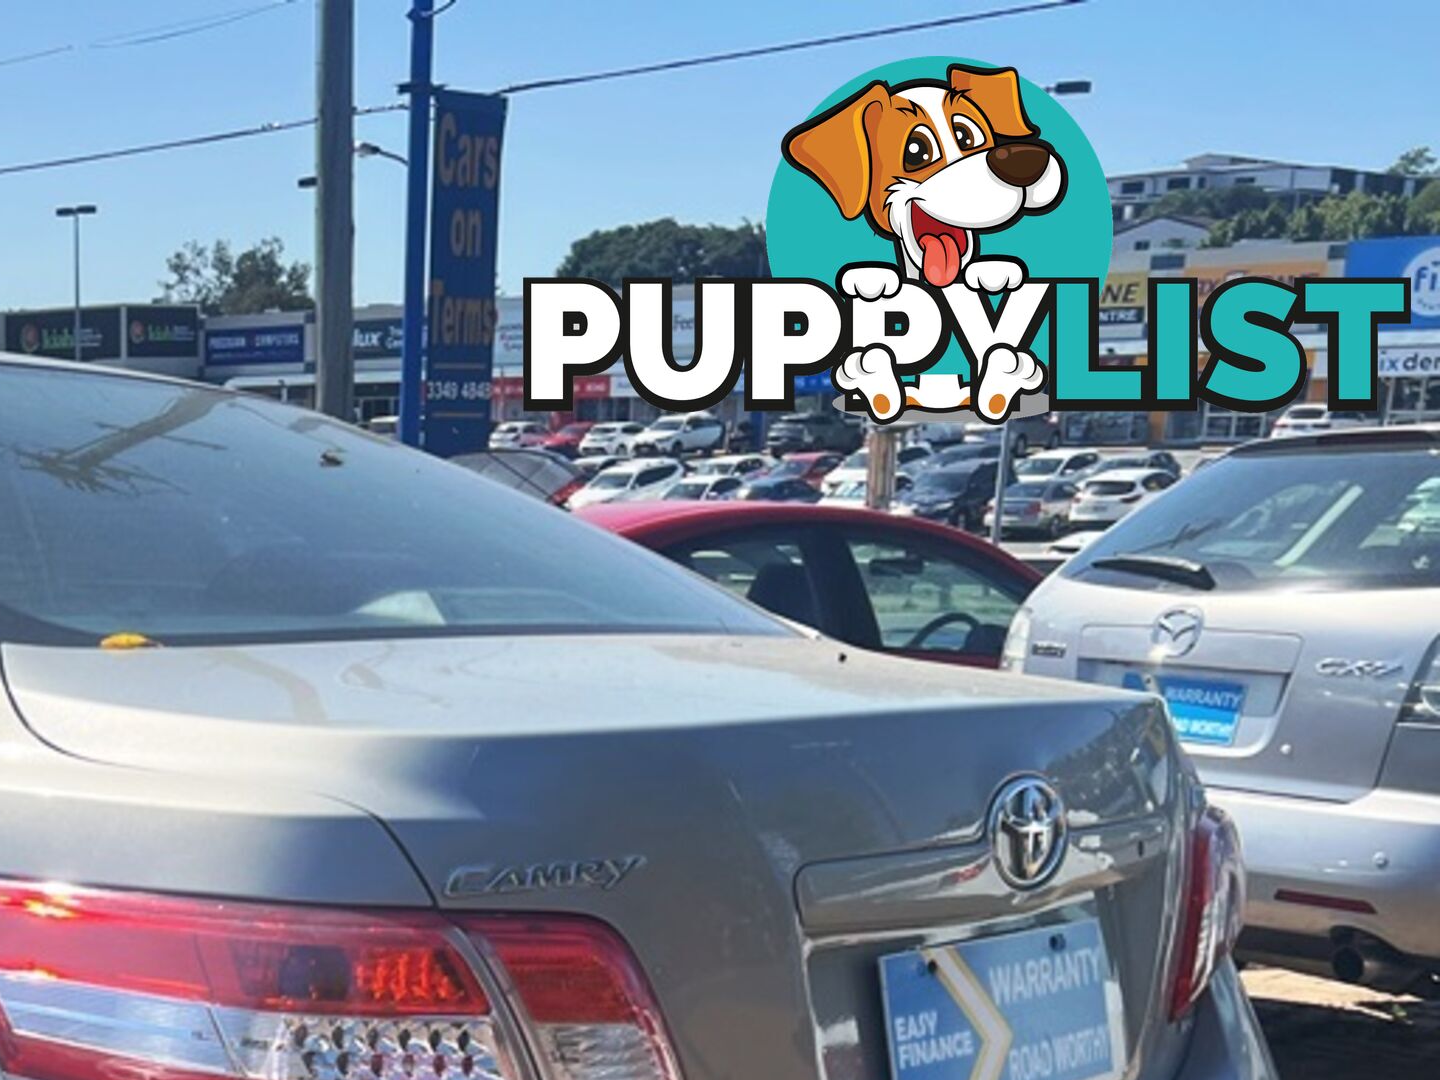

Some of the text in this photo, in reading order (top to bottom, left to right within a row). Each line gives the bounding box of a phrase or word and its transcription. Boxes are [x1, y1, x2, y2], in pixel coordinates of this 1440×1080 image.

[437, 112, 498, 190] Cars
[449, 208, 482, 257] on
[1100, 282, 1140, 305] NE
[1414, 261, 1440, 292] fi
[431, 279, 496, 346] Terms
[1378, 349, 1400, 372] ix
[427, 381, 458, 401] 3349
[1166, 686, 1242, 710] WARRANTY
[445, 855, 648, 897] CAMRY
[989, 947, 1102, 1005] WARRANTY
[894, 1011, 938, 1042] EASY
[898, 1030, 975, 1070] FINANCE
